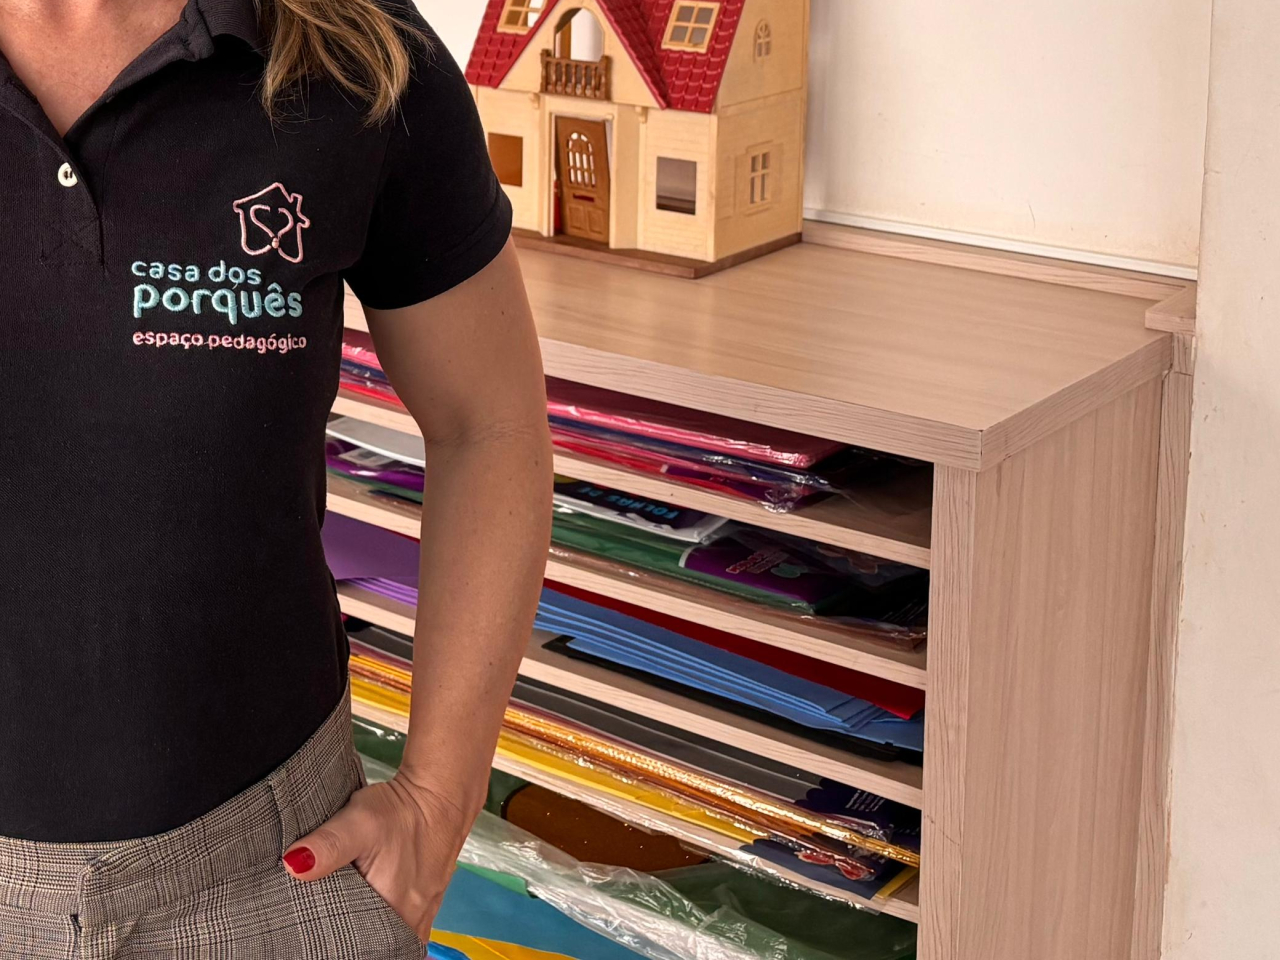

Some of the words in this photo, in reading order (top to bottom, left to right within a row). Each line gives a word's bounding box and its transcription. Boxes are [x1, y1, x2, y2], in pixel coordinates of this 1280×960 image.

[131, 261, 201, 282] casa
[208, 259, 262, 285] dos
[133, 282, 303, 325] porquês
[132, 331, 204, 349] espaço
[208, 333, 307, 354] pedagógico
[605, 494, 680, 520] FOLHAS
